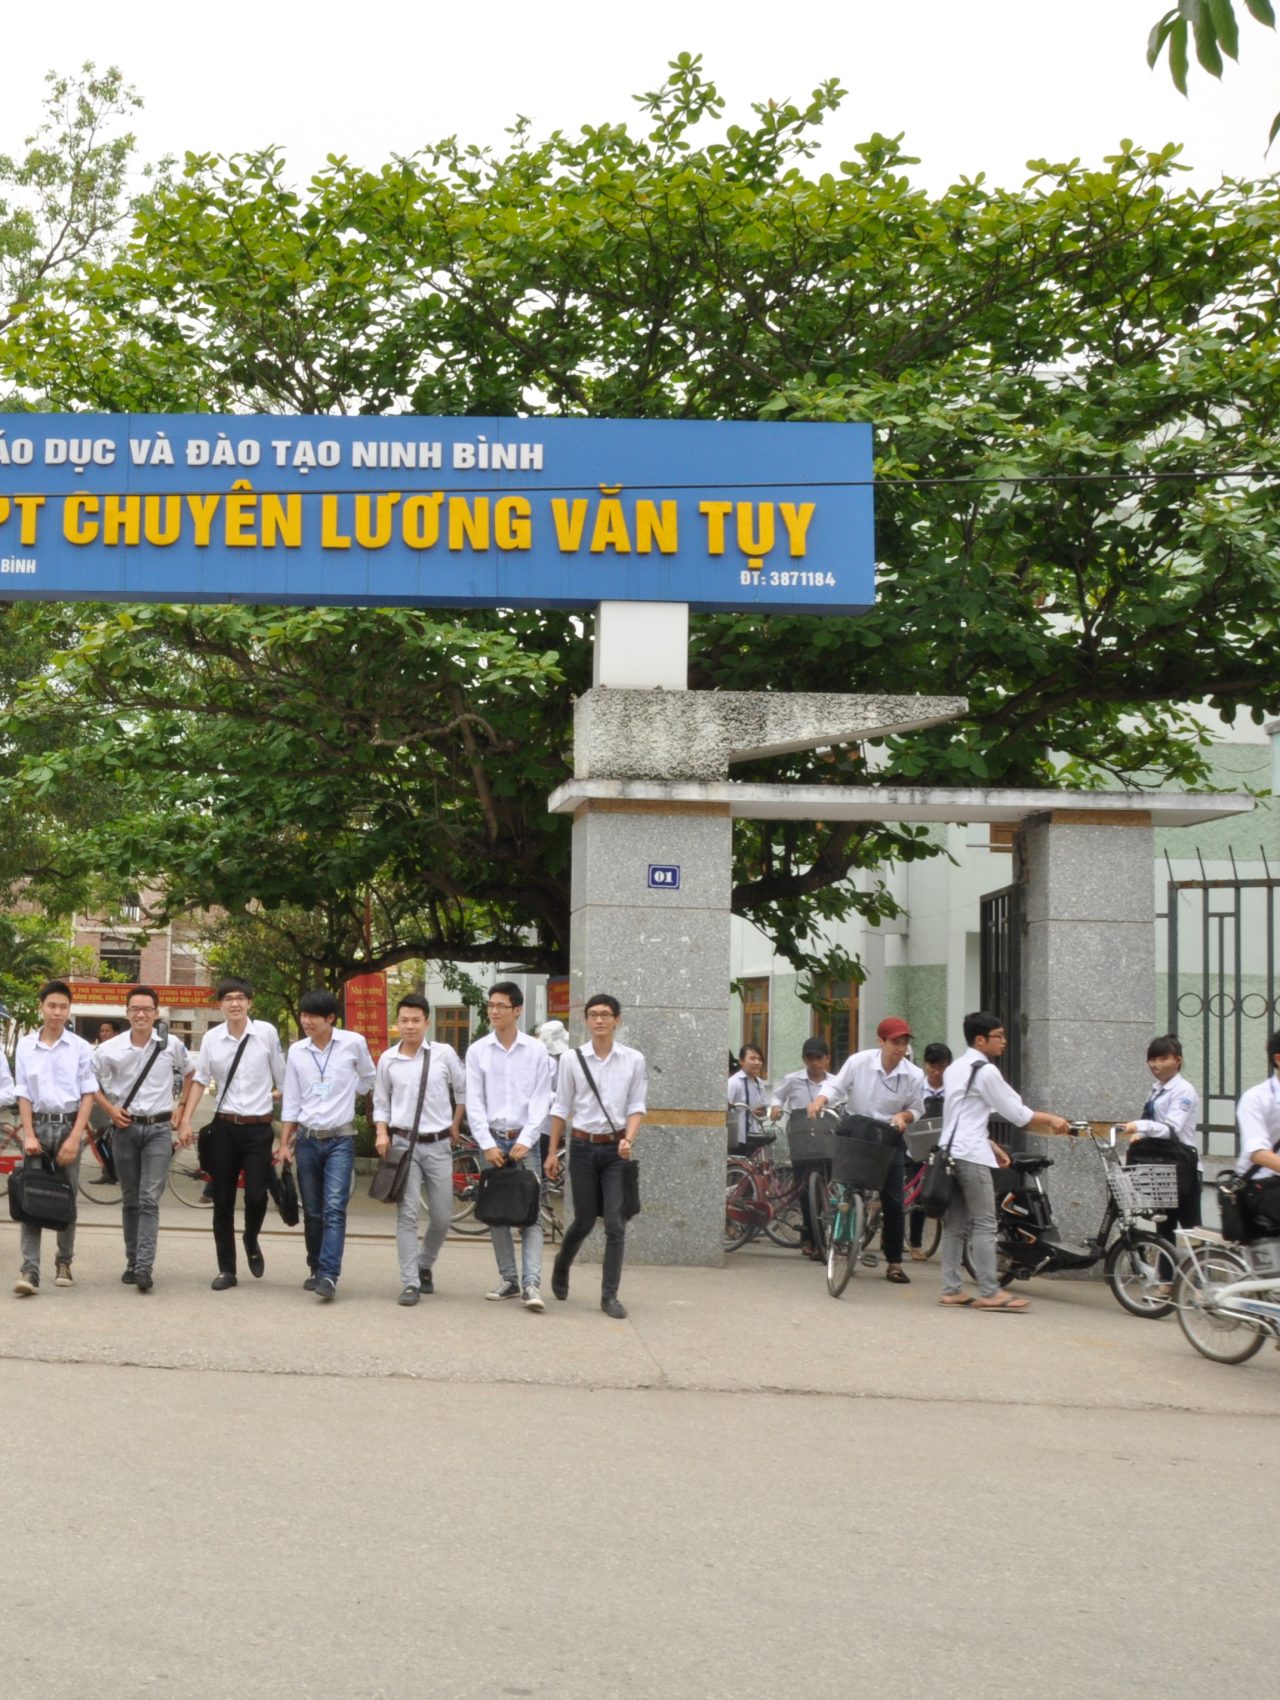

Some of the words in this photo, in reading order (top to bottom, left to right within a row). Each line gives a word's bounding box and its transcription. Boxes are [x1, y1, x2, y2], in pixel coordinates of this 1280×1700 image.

[44, 438, 116, 473] DỤC
[129, 431, 175, 465] VÀ
[185, 432, 261, 466] ĐÀO
[271, 440, 341, 474] TẠO
[351, 441, 442, 469] NINH
[452, 434, 544, 470] BÌNH
[63, 479, 302, 547] CHUYÊN
[321, 491, 532, 550] LƯƠNG
[550, 483, 678, 553] VĂN
[699, 500, 817, 569] TỤY
[0, 555, 37, 574] BÌNH
[770, 571, 837, 587] 3871184
[654, 870, 674, 883] 01
